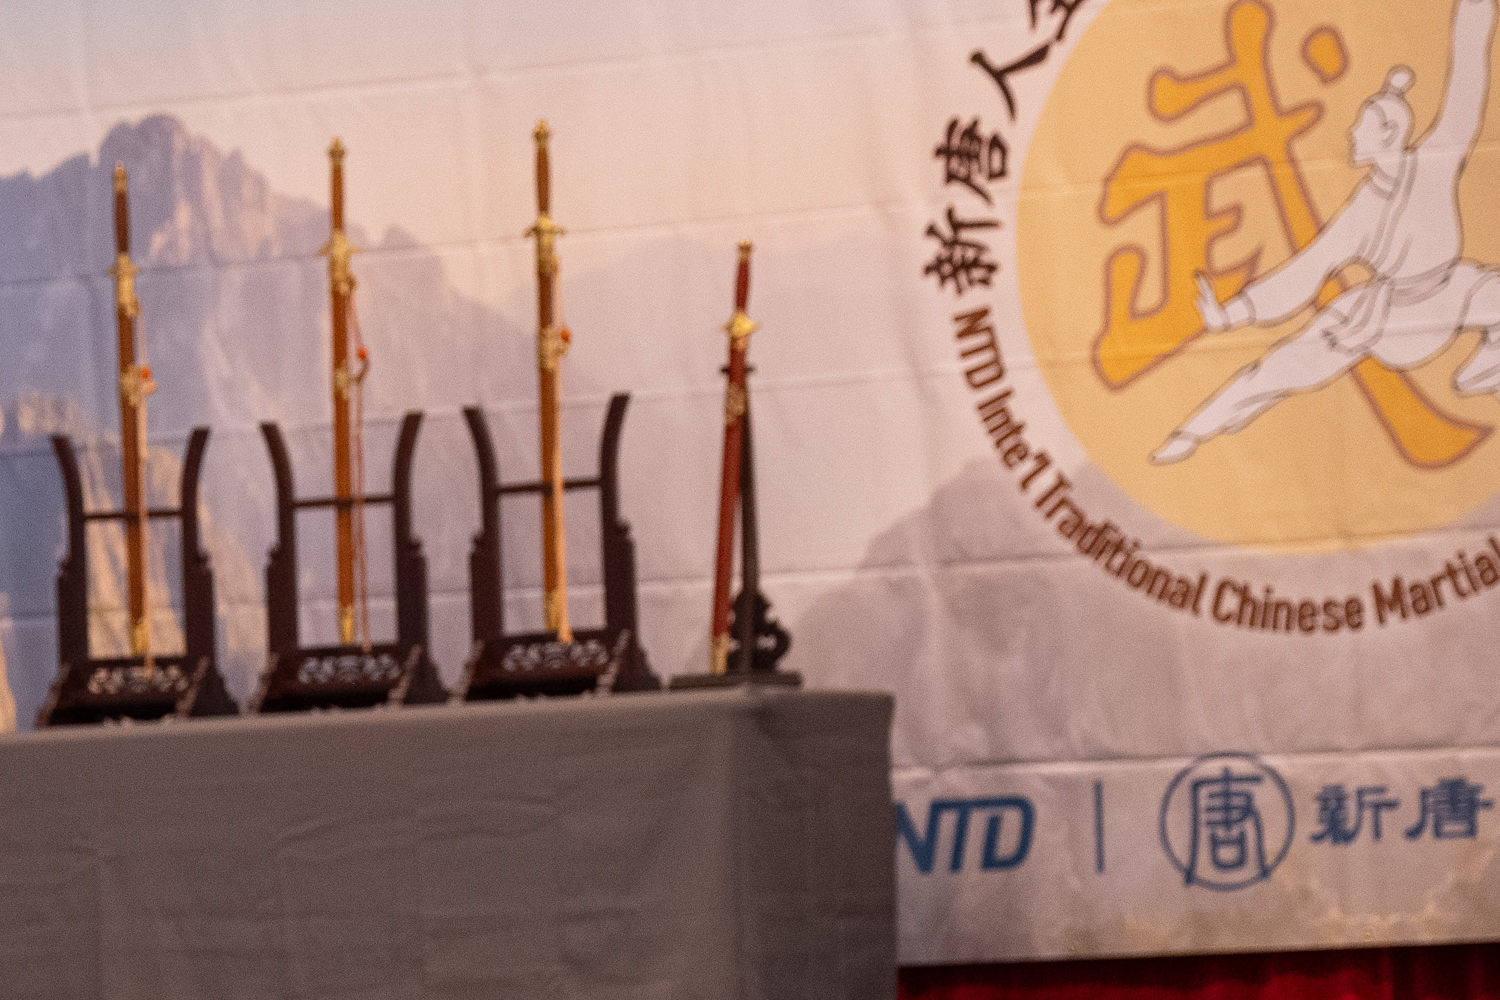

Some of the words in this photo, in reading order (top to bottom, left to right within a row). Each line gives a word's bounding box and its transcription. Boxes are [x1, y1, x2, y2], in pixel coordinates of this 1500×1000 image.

[953, 306, 1006, 391] NTD
[1033, 471, 1208, 617] Traditional
[1211, 574, 1365, 634] Chinese
[895, 795, 1037, 874] NTD
[1309, 776, 1494, 845] 新唐
